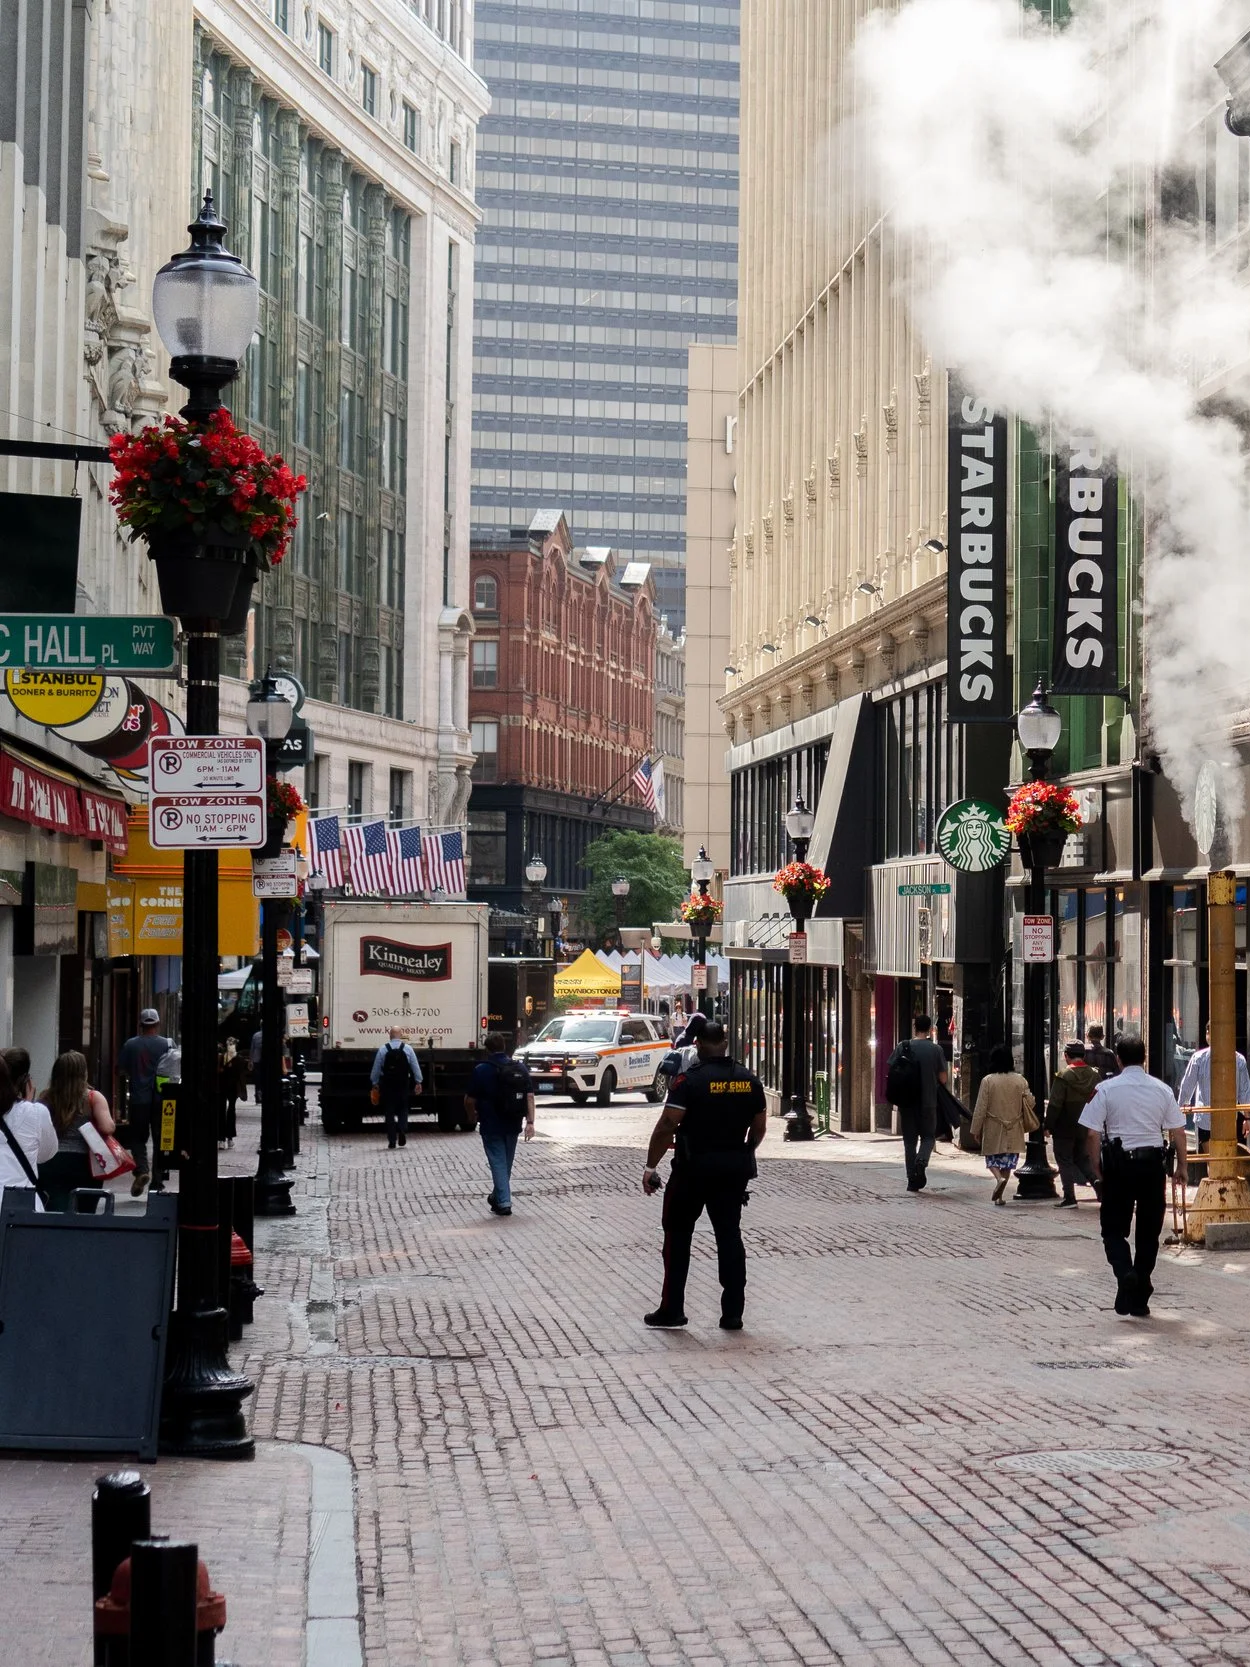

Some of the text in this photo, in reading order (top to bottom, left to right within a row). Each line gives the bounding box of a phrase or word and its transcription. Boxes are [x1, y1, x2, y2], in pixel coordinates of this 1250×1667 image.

[959, 395, 994, 702] STARBUCKS
[1065, 435, 1104, 669] RBUCKS
[132, 625, 155, 638] PVT
[24, 625, 96, 663] HALL
[101, 644, 119, 664] PL
[132, 642, 155, 655] WAY
[12, 688, 46, 696] DONER
[56, 689, 97, 697] BURRITO
[167, 740, 246, 749] TOW ZONE
[182, 751, 216, 759] COMMERCIAL
[217, 751, 242, 759] VEHICLES
[170, 797, 247, 805] TOW ZONE
[186, 814, 256, 824] NO STOPPING
[159, 886, 183, 896] THE
[902, 885, 931, 895] JACKSON
[140, 897, 184, 908] CORNE
[368, 944, 443, 971] Kinnealey
[378, 962, 404, 972] QUALITY
[371, 1008, 441, 1017] 508-638-7700
[358, 1026, 453, 1036] www.knealey.com
